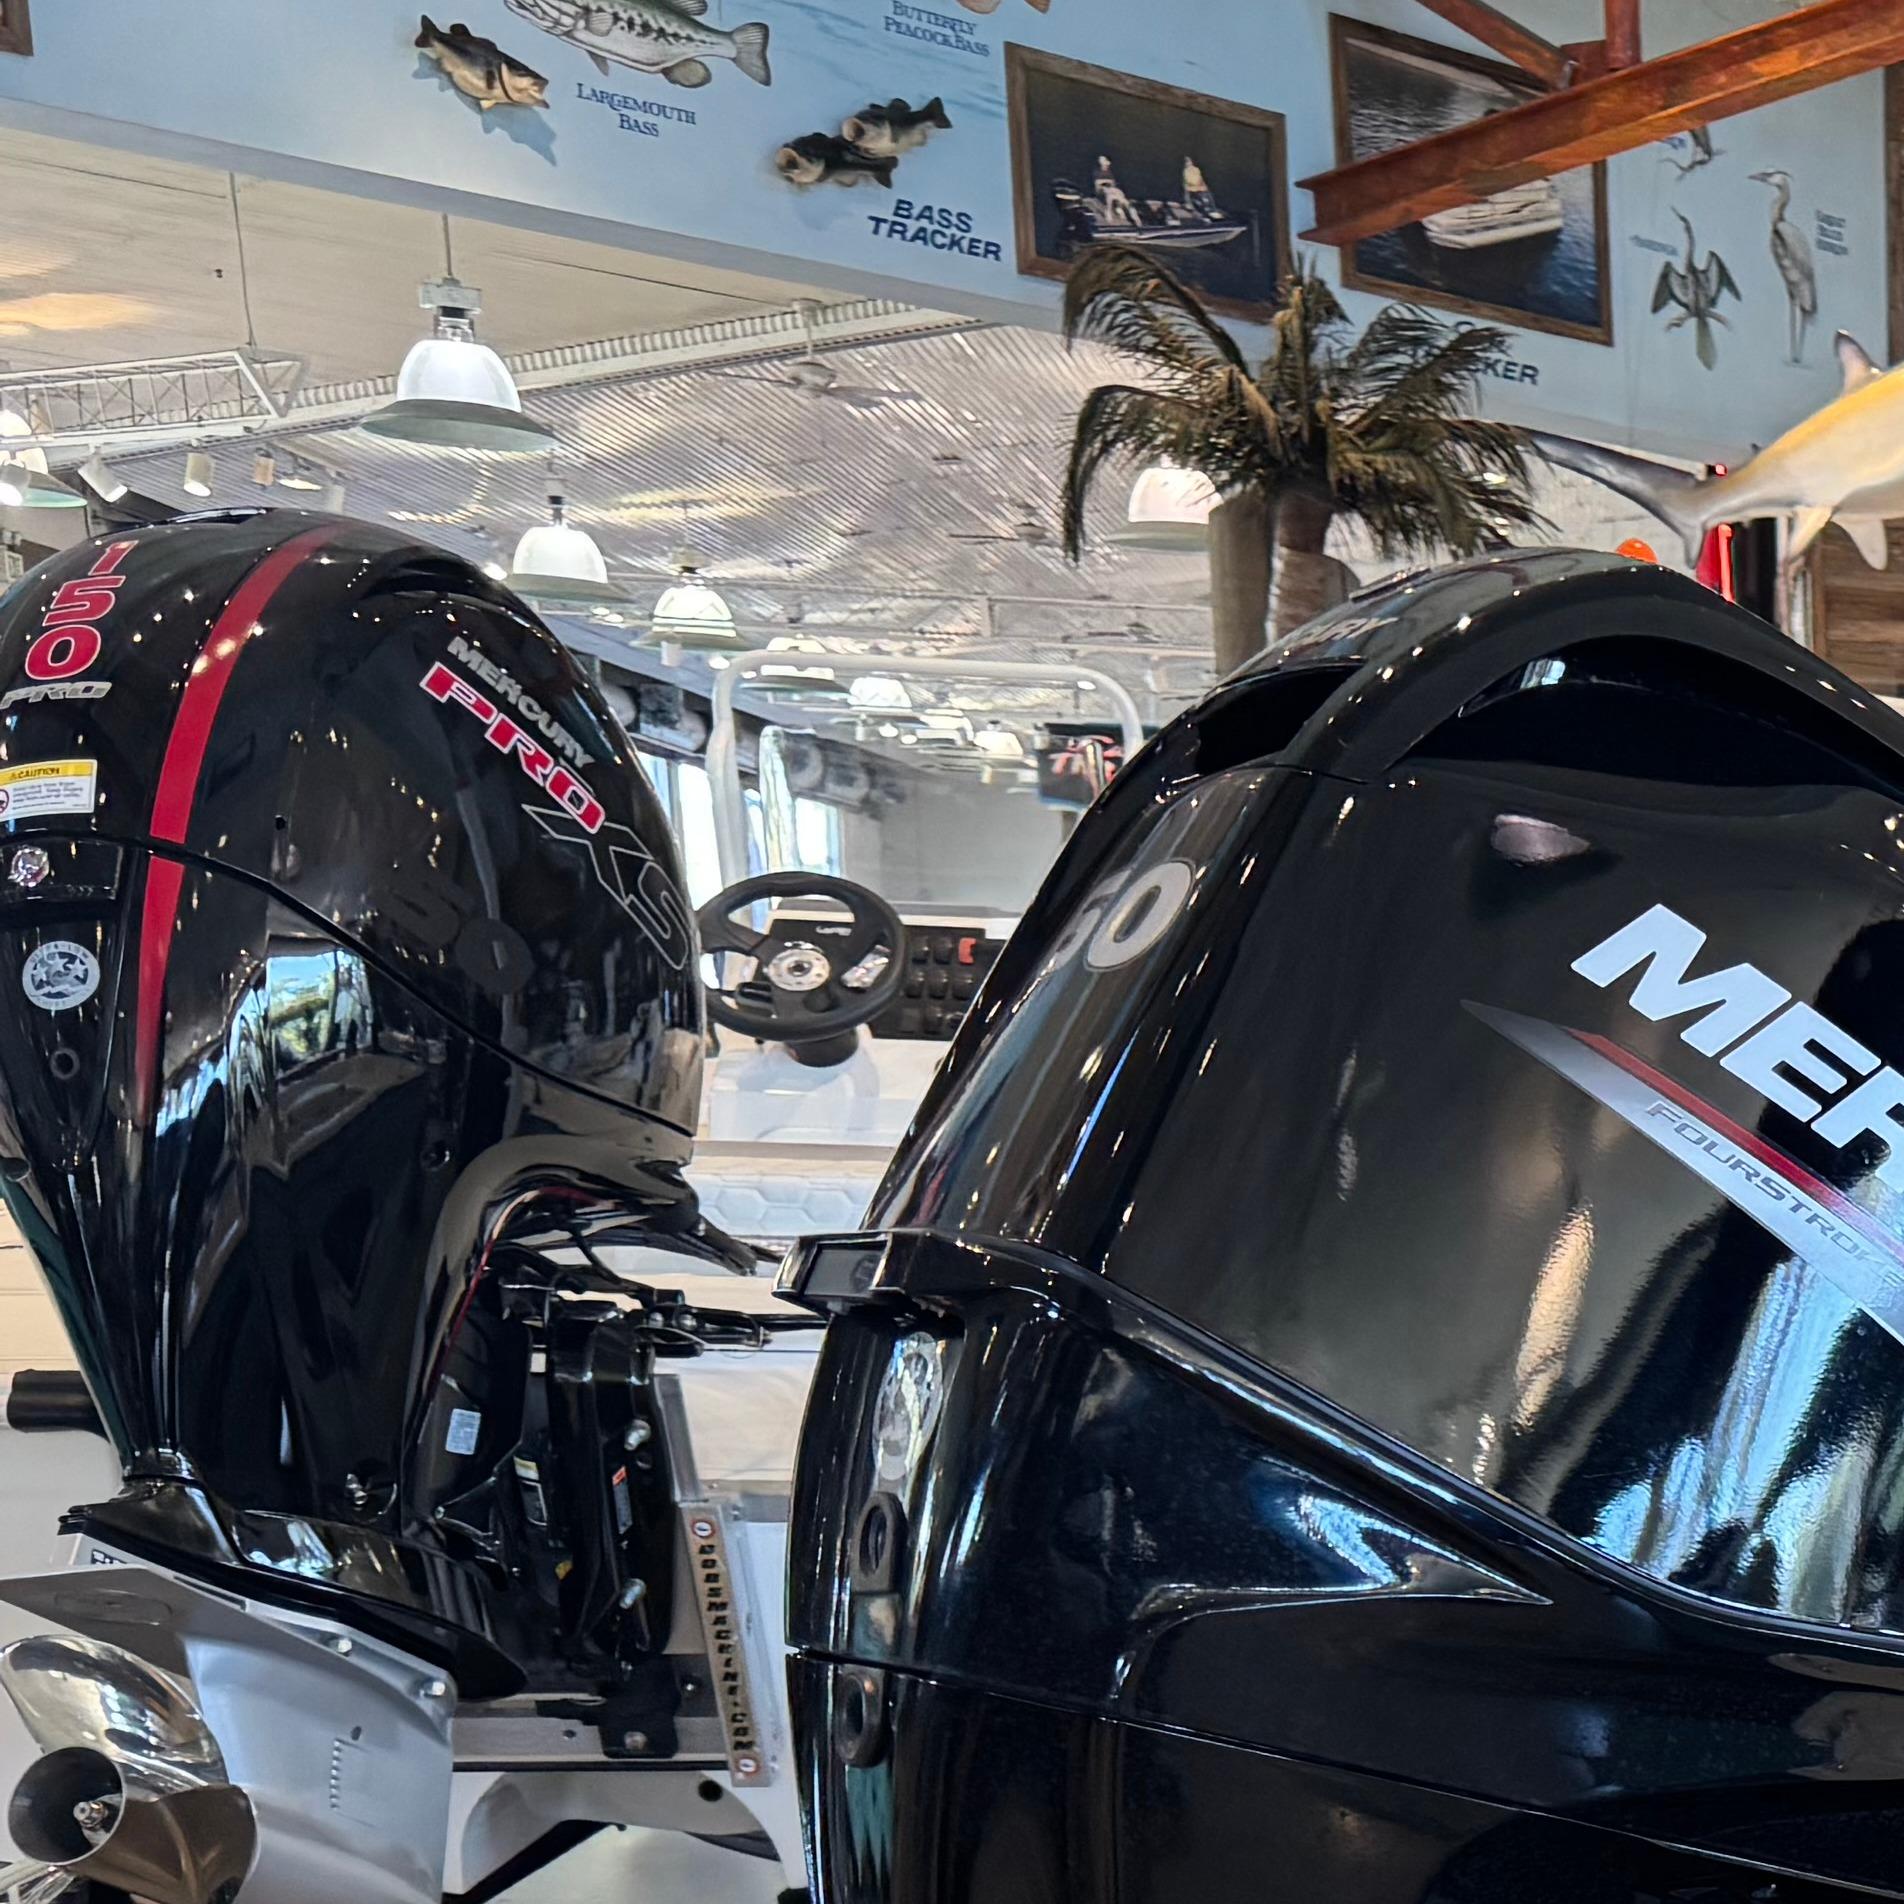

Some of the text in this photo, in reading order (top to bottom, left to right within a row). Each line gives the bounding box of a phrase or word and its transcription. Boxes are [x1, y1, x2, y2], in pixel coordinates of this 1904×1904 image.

[884, 16, 990, 57] PEACOCK BASS
[893, 1, 978, 36] BUTTERFLY
[576, 82, 697, 126] LARGEMOUTH
[618, 113, 660, 138] BASS
[867, 214, 1002, 262] TRACKER
[892, 198, 974, 235] BASS
[25, 540, 139, 681] 150
[447, 635, 596, 768] MERCURY
[419, 661, 606, 835] PRO
[1646, 1099, 1900, 1290] FOURSTROKE
